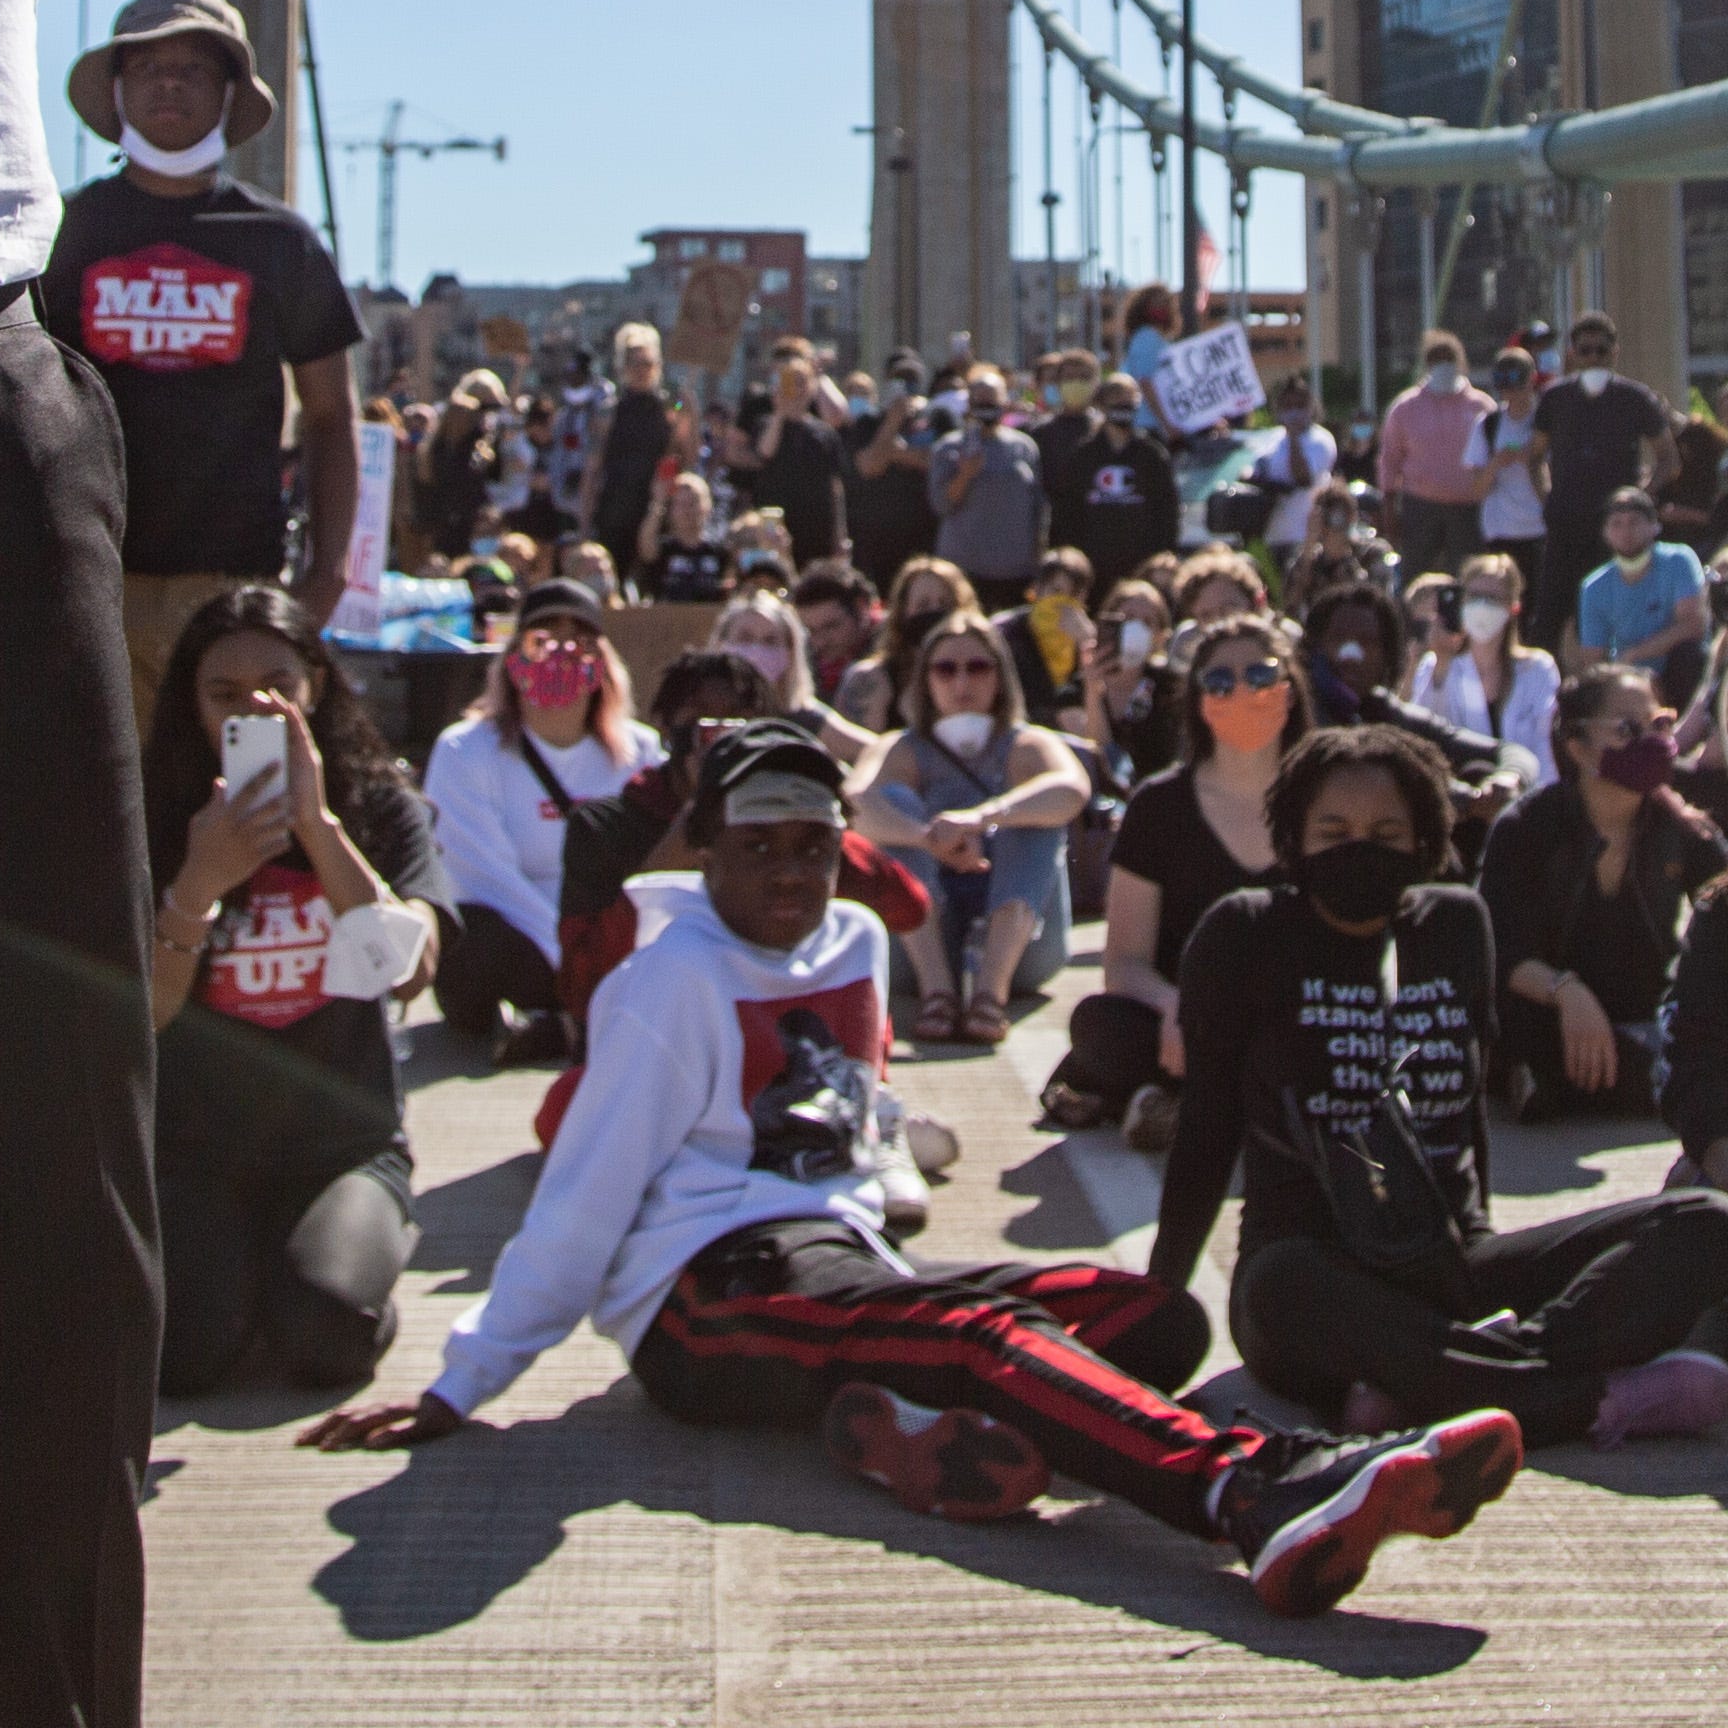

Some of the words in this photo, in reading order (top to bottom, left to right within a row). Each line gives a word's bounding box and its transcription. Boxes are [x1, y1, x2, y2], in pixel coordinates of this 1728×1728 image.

[93, 276, 240, 320] MAN
[234, 948, 326, 994] UP
[1331, 984, 1376, 1004] we
[1300, 1008, 1384, 1029] stand
[1393, 1014, 1433, 1035] up
[1421, 1071, 1464, 1091] we
